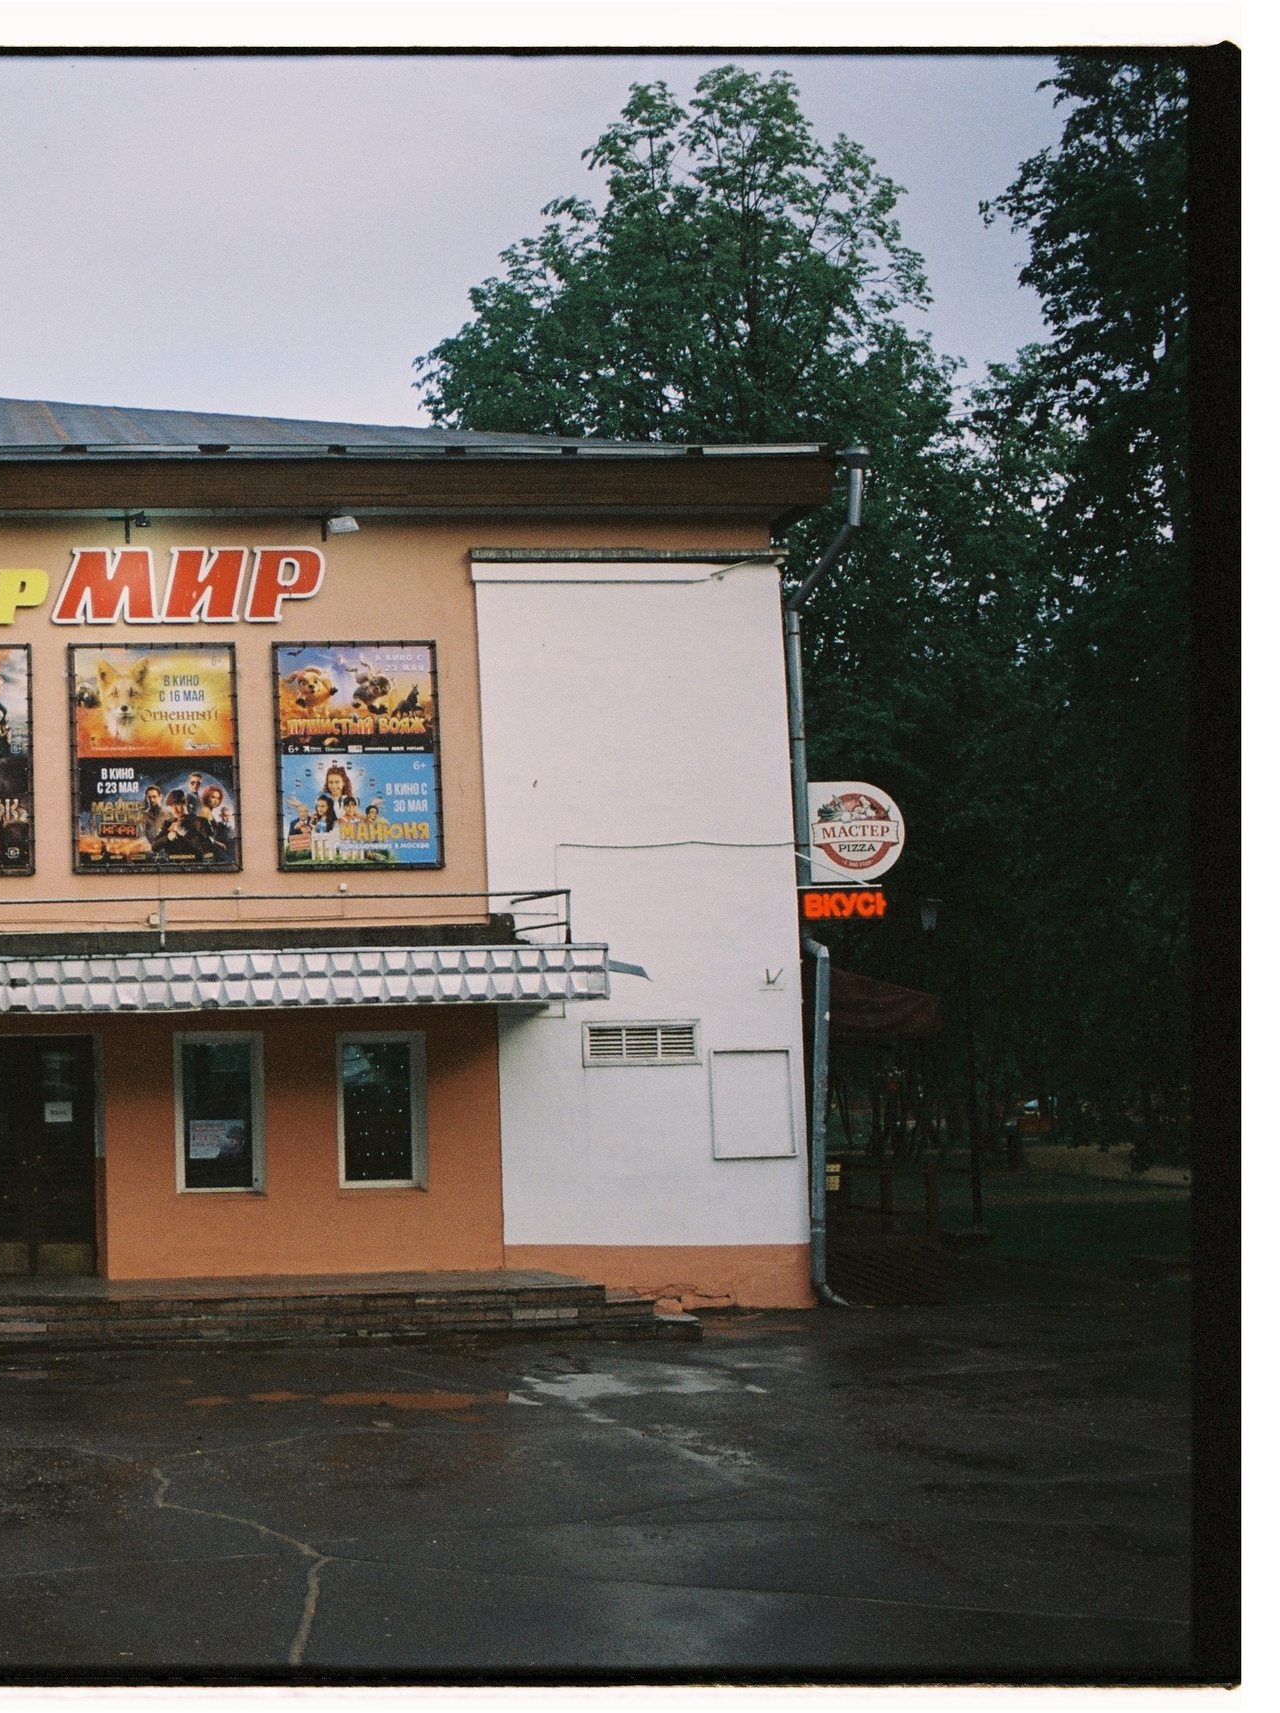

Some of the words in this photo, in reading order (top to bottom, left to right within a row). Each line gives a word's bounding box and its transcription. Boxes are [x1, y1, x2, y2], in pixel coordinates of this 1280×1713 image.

[50, 545, 326, 625] МИР
[163, 675, 170, 687] В
[172, 674, 200, 687] КИНО
[159, 690, 166, 702] С
[169, 690, 180, 702] 16
[183, 690, 205, 701] МАЯ
[287, 716, 374, 735] ПУШИСТЫЙ
[378, 717, 427, 734] ВОЯЖ
[287, 745, 299, 753] 6+
[412, 760, 427, 770] 6+
[101, 768, 108, 780] В
[109, 767, 134, 780] КИНО
[97, 782, 104, 794] С
[105, 782, 117, 794] 23
[118, 782, 139, 794] МАЯ
[385, 783, 392, 795] В
[394, 782, 419, 795] КИНО
[421, 782, 428, 795] С
[393, 799, 406, 812] 30
[407, 799, 428, 812] МАЯ
[340, 821, 430, 840] МАНЮНЯ
[821, 824, 890, 839] МАСТЕР
[838, 843, 876, 853] PIZZA
